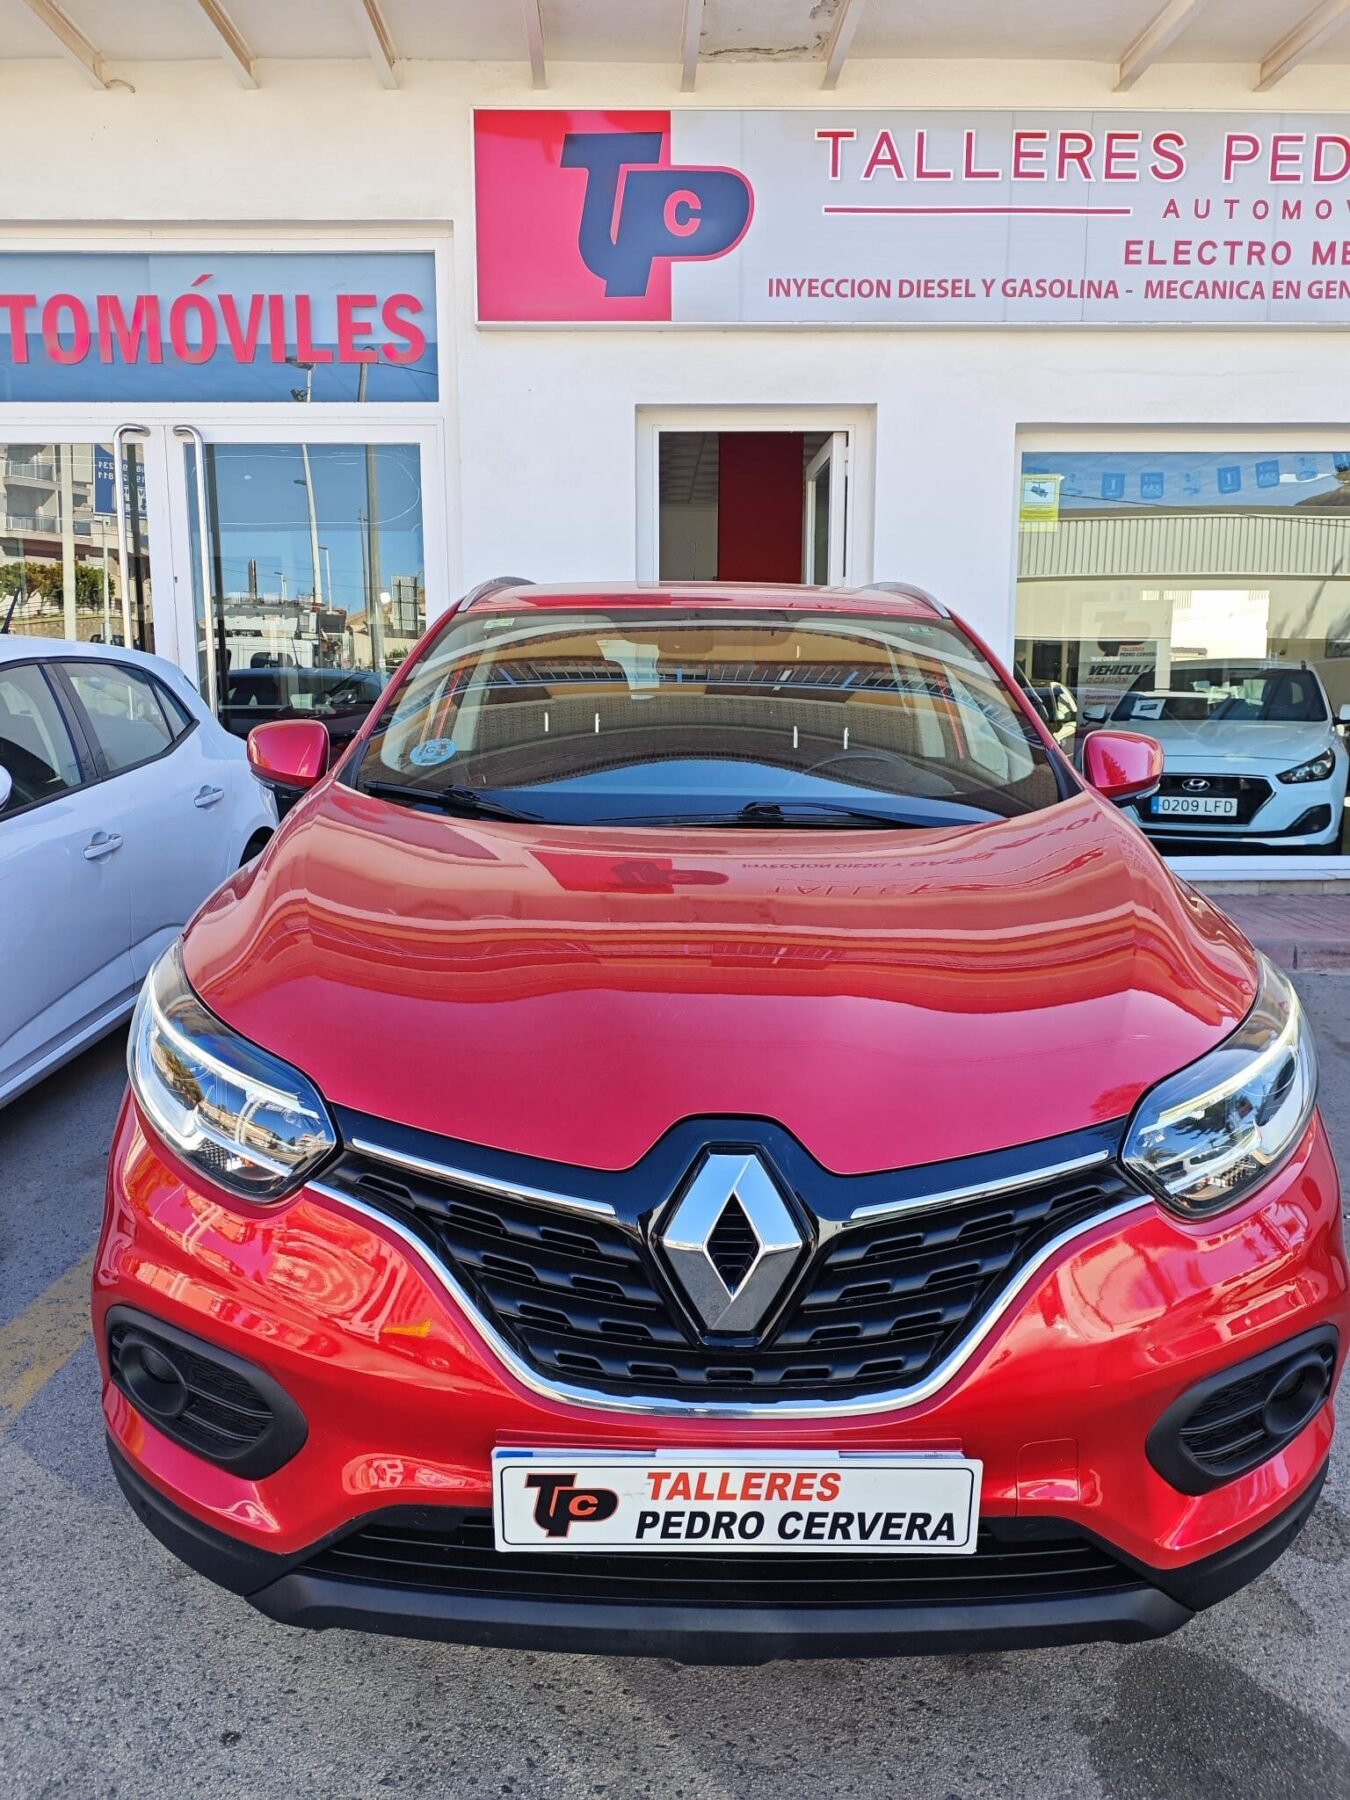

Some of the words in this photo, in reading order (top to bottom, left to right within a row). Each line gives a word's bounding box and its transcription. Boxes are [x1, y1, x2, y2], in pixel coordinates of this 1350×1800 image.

[815, 128, 1187, 182] TALLERES
[1223, 132, 1350, 183] PED
[1162, 198, 1350, 220] AUTOMO
[1124, 240, 1292, 266] ELECTRO
[768, 278, 891, 298] INYECCION
[898, 279, 976, 298] DIESEL
[981, 279, 996, 298] Y
[1001, 278, 1119, 299] GASOLINA
[1144, 280, 1266, 300] MECANICA
[1272, 281, 1301, 299] EN
[1307, 280, 1350, 299] GEN
[0, 273, 427, 366] TOMÓVILES
[1088, 664, 1154, 675] VEHICUL
[1162, 799, 1199, 812] 0209
[1204, 800, 1233, 813] LFD
[647, 1472, 842, 1501] TALLERES
[635, 1511, 765, 1540] PEDRO
[777, 1511, 955, 1541] CERVERA
